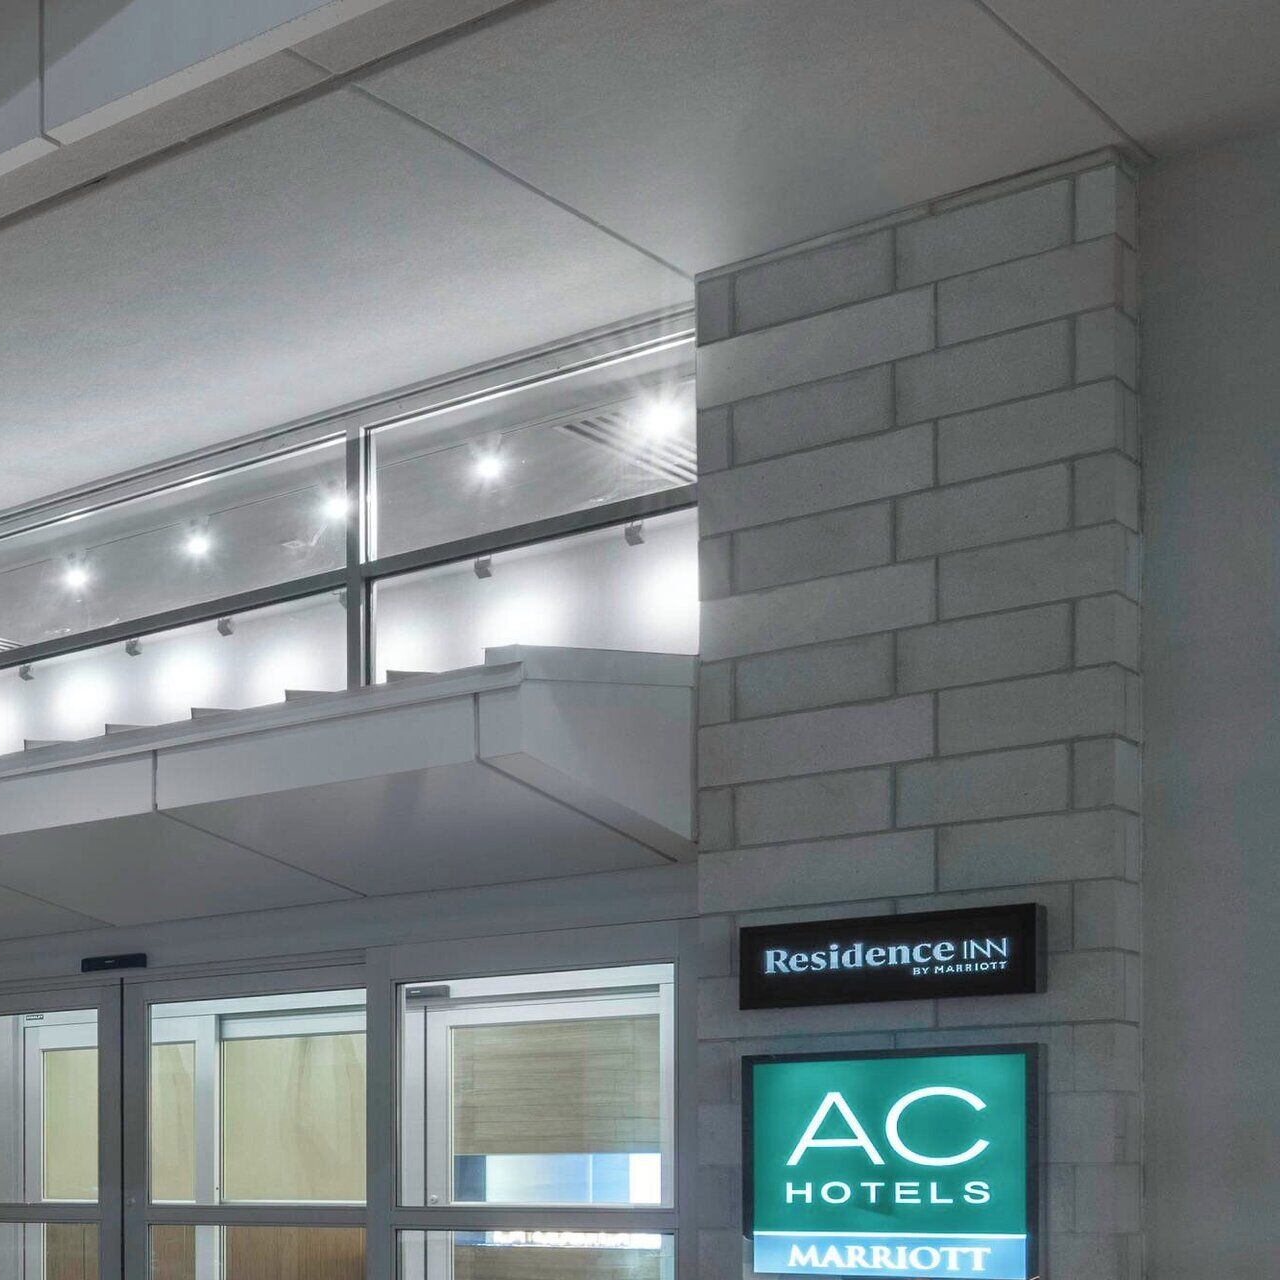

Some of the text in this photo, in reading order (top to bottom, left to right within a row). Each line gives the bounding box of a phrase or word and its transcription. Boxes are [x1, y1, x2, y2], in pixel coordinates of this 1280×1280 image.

[764, 937, 1008, 975] Residence INN
[912, 961, 1008, 976] BY MARRIOTT
[785, 1085, 990, 1167] AC
[785, 1180, 991, 1205] HOTELS
[787, 1243, 992, 1272] MARRIOTT
